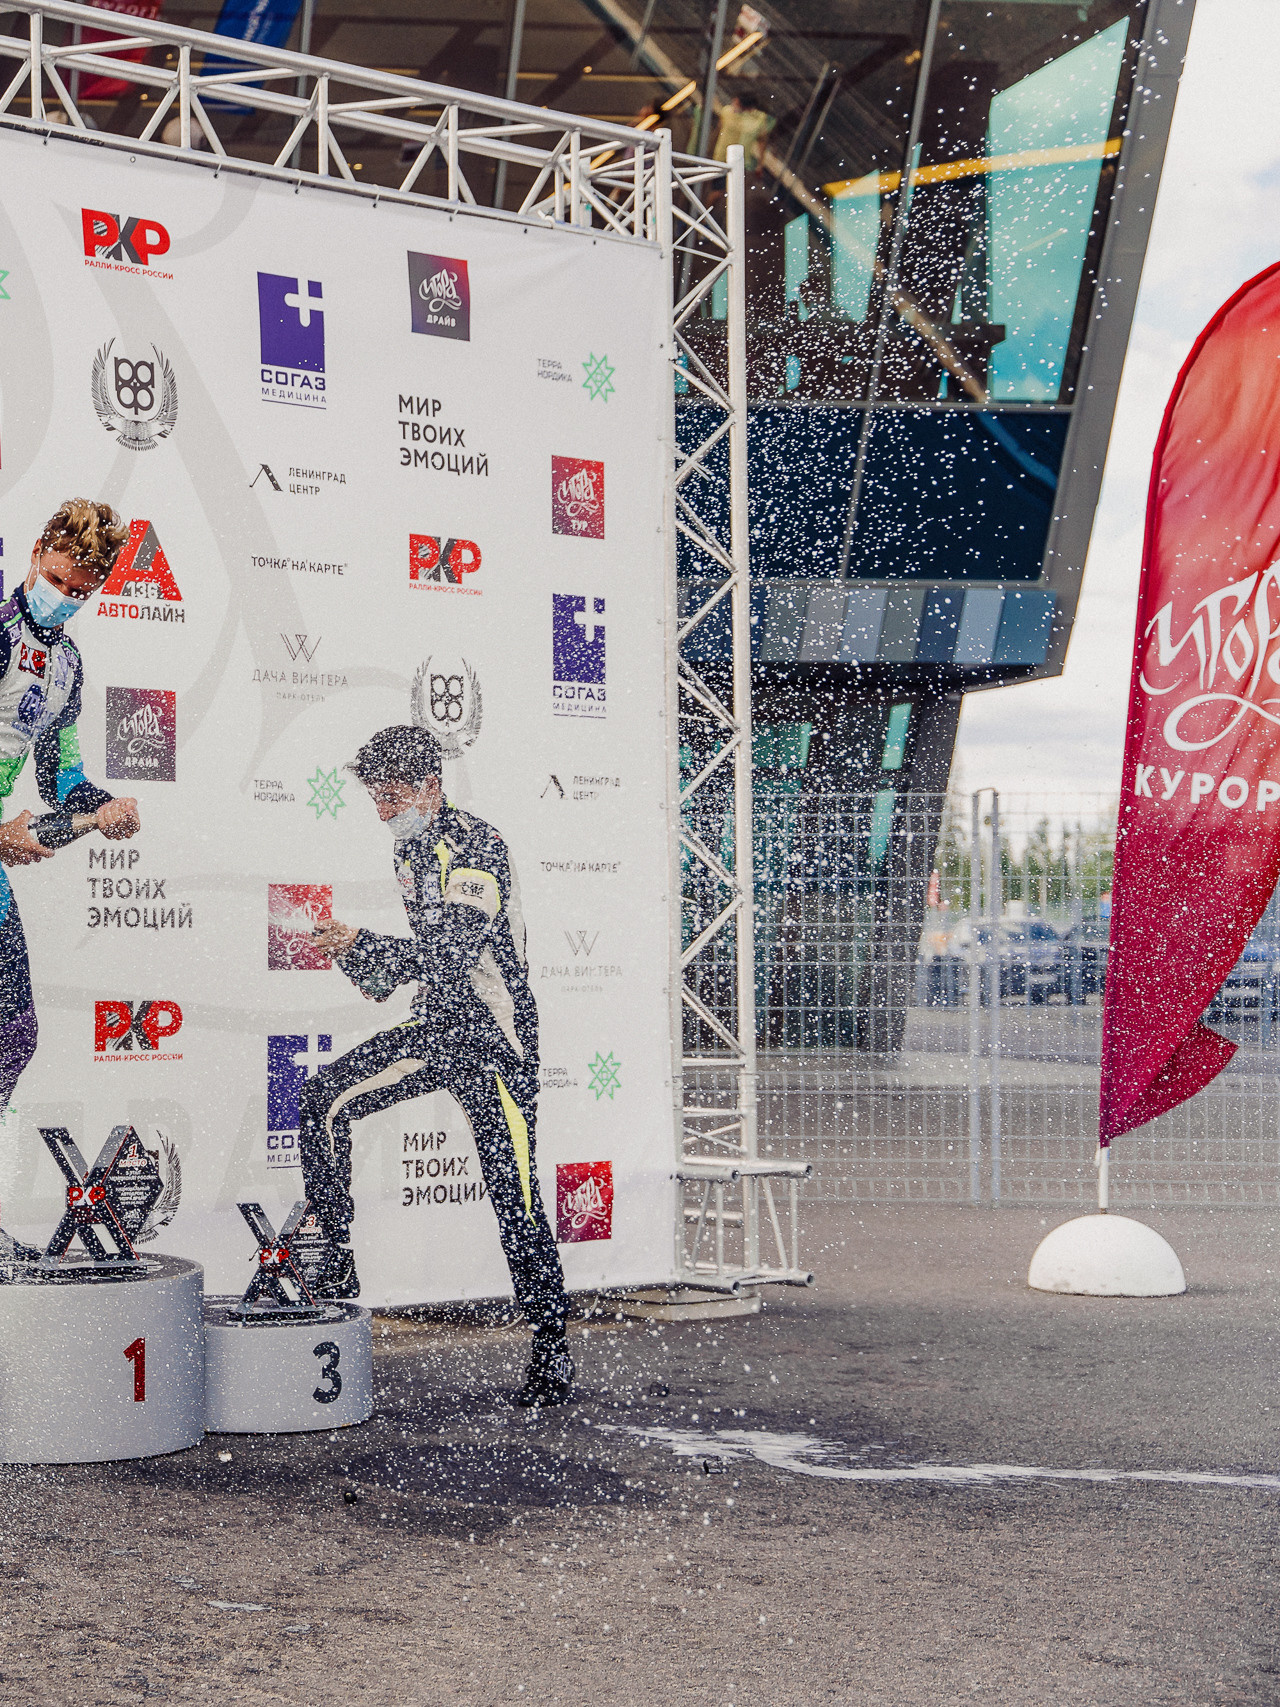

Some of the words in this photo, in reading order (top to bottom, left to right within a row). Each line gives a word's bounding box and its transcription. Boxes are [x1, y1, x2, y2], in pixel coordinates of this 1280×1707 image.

[84, 259, 141, 276] РАЛЛИ-КРОСС
[142, 268, 174, 280] РОССИИ
[426, 313, 456, 328] ДРАЙВ
[537, 358, 562, 370] ТЕРРА
[261, 368, 327, 391] СОГАЗ
[537, 369, 573, 383] НОРДИКА
[261, 387, 327, 404] МЕДИЦИНА
[398, 395, 442, 418] МИР
[398, 421, 466, 448] ТВОИХ
[399, 448, 489, 477] ЭМОЦИЙ
[288, 467, 347, 485] ЛЕНИНГРАД
[288, 483, 320, 496] ЦЕНТР
[97, 602, 185, 624] АВТОЛАЙН
[252, 669, 287, 685] ДАЧА
[292, 671, 349, 688] ВИНТЕРА
[553, 685, 606, 702] СОГАЗ
[254, 780, 284, 791] ТЕРРА
[254, 791, 296, 803] НОРДИКА
[89, 848, 140, 870] МИР
[87, 877, 166, 900] ТВОИХ
[87, 903, 193, 932] ЭМОЦИЙ
[403, 1132, 446, 1153] МИР
[402, 1156, 469, 1180] ТВОИХ
[123, 1337, 146, 1402] 1
[312, 1341, 343, 1404] 3
